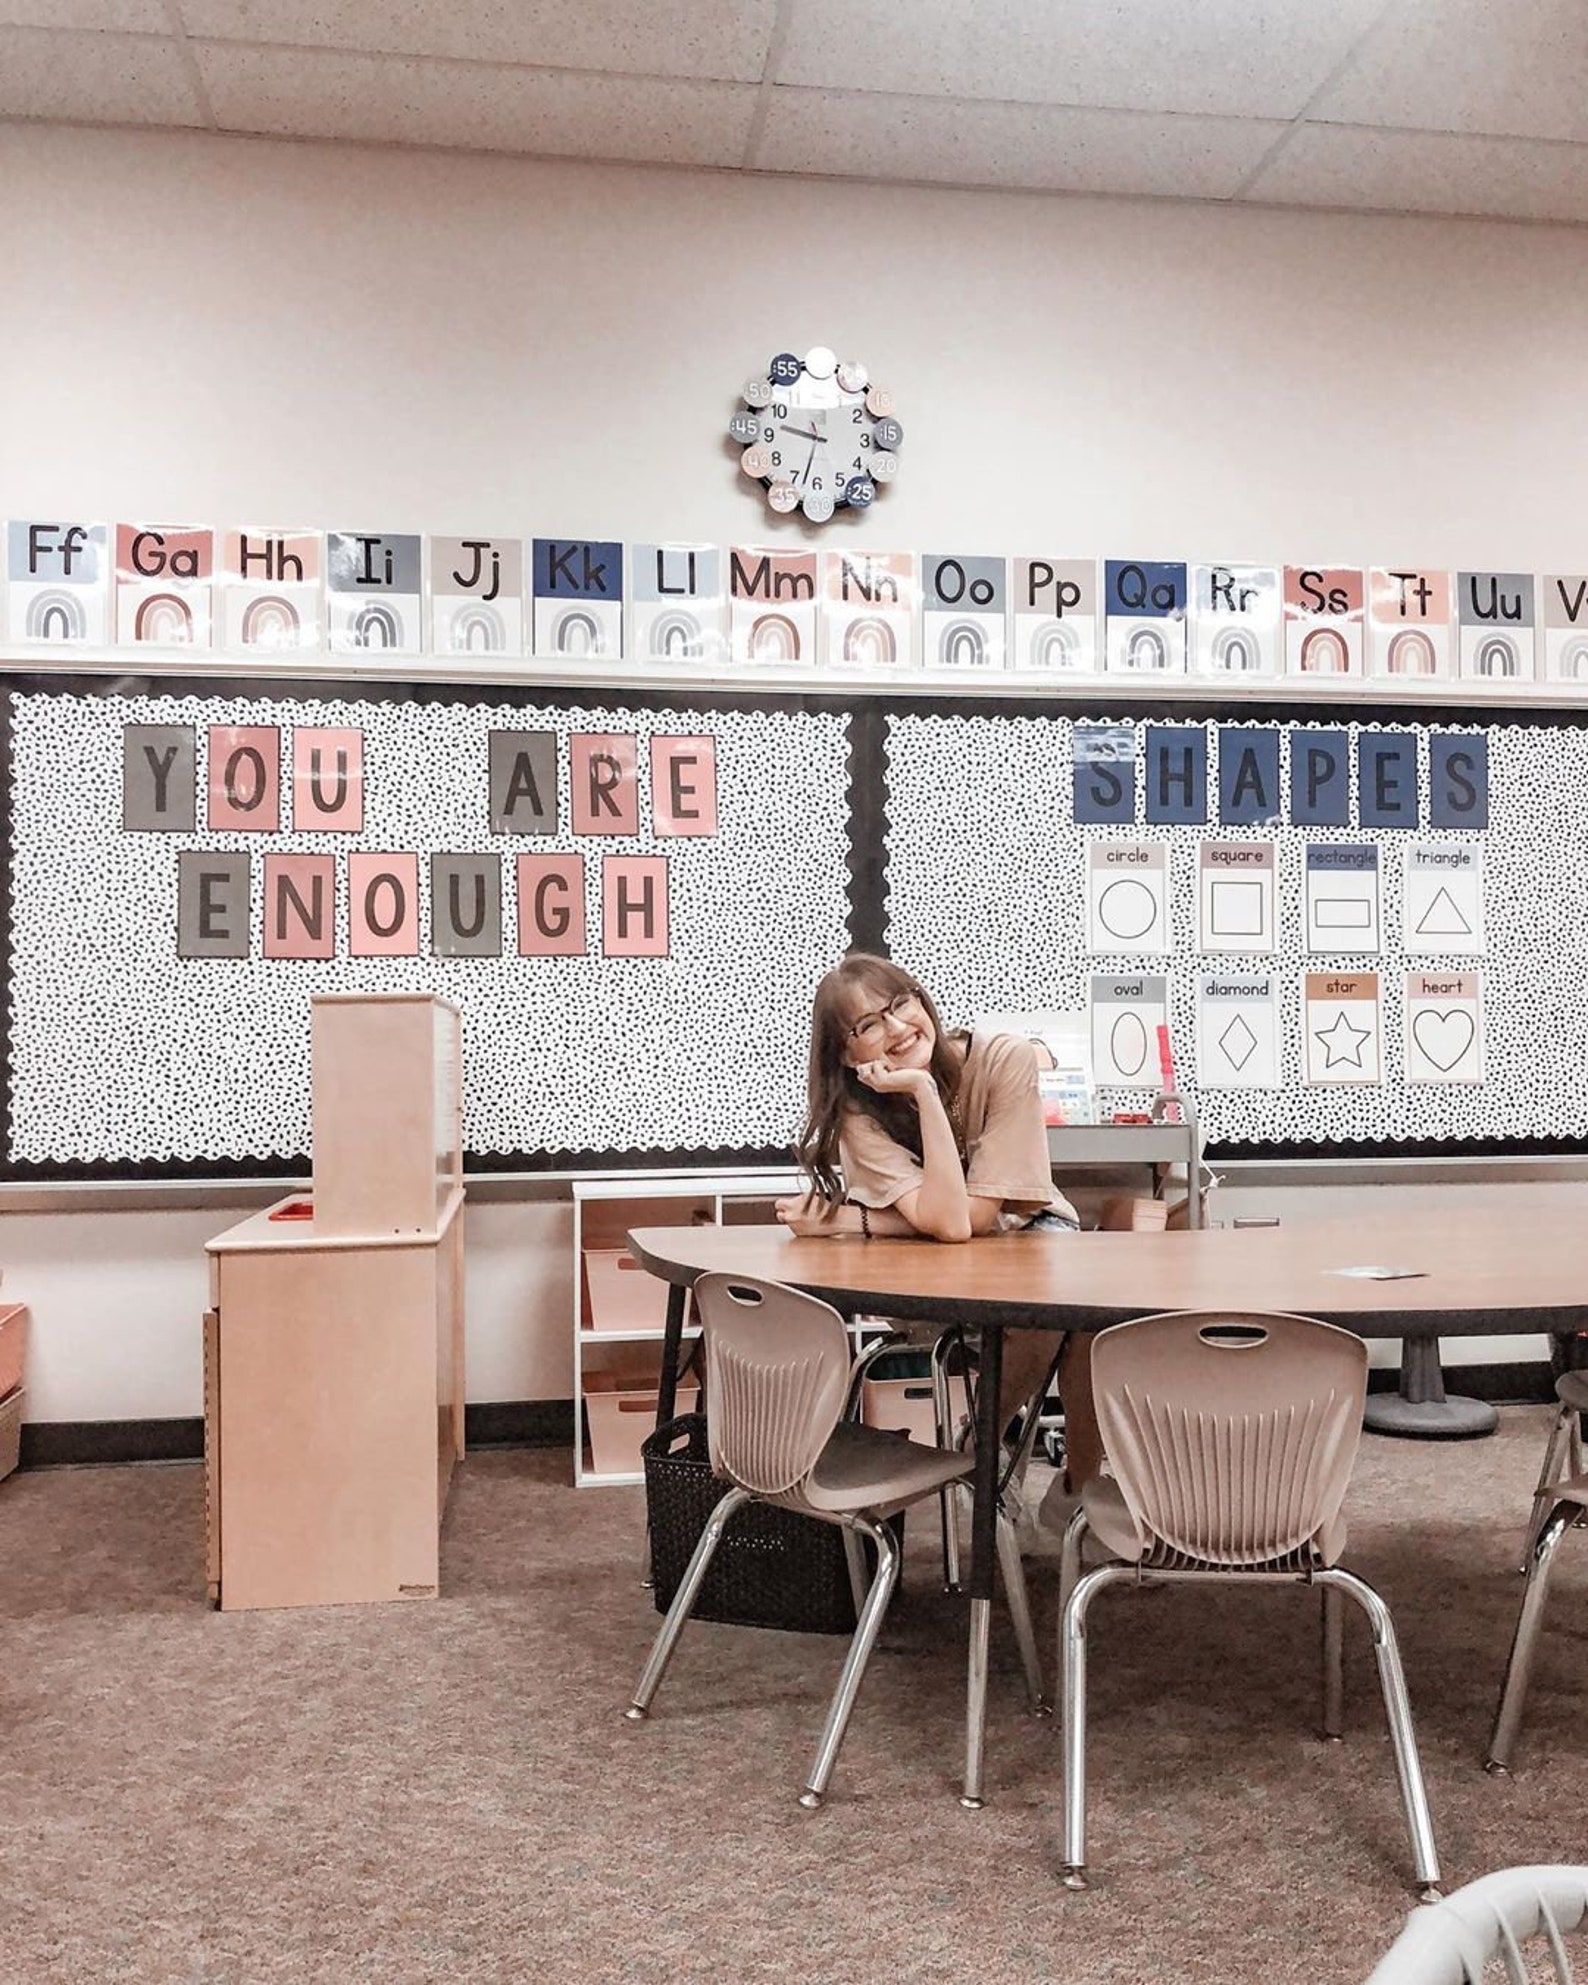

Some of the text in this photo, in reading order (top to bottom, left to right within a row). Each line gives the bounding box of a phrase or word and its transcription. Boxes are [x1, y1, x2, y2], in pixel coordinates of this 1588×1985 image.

[773, 360, 798, 378] :55
[771, 403, 788, 420] 10
[852, 408, 863, 424] 2
[731, 419, 757, 436] :45
[764, 427, 774, 443] 9
[860, 434, 870, 449] 3
[771, 451, 782, 467] 8
[852, 456, 862, 470] 4
[789, 470, 800, 484] 7
[812, 477, 823, 491] 6
[835, 472, 845, 487] 5
[847, 483, 872, 501] :25
[29, 524, 88, 576] Ff
[240, 534, 303, 581] Hh
[355, 537, 394, 584] Ii
[549, 544, 607, 592] Kk
[452, 541, 500, 601] Jj
[656, 549, 696, 595] Ll
[730, 551, 814, 599] Mm
[842, 556, 899, 603] Nn
[934, 559, 995, 605] Oo
[1029, 561, 1081, 619] Pp
[1211, 567, 1259, 612] Rr
[1299, 571, 1349, 614] Ss
[1388, 572, 1433, 617] Tt
[1470, 575, 1522, 620] Uu
[1557, 579, 1588, 622] V
[143, 745, 699, 819] YOU ARE
[1089, 742, 1477, 812] SHAPES
[1106, 847, 1149, 862] circle
[1211, 850, 1264, 865] square
[1307, 849, 1377, 868] rectangle
[1415, 849, 1471, 868] triangle
[199, 872, 655, 941] ENOUGH
[1113, 980, 1143, 996] oval
[1205, 979, 1269, 996] diamond
[1326, 979, 1358, 994] star
[1422, 978, 1463, 994] heart
